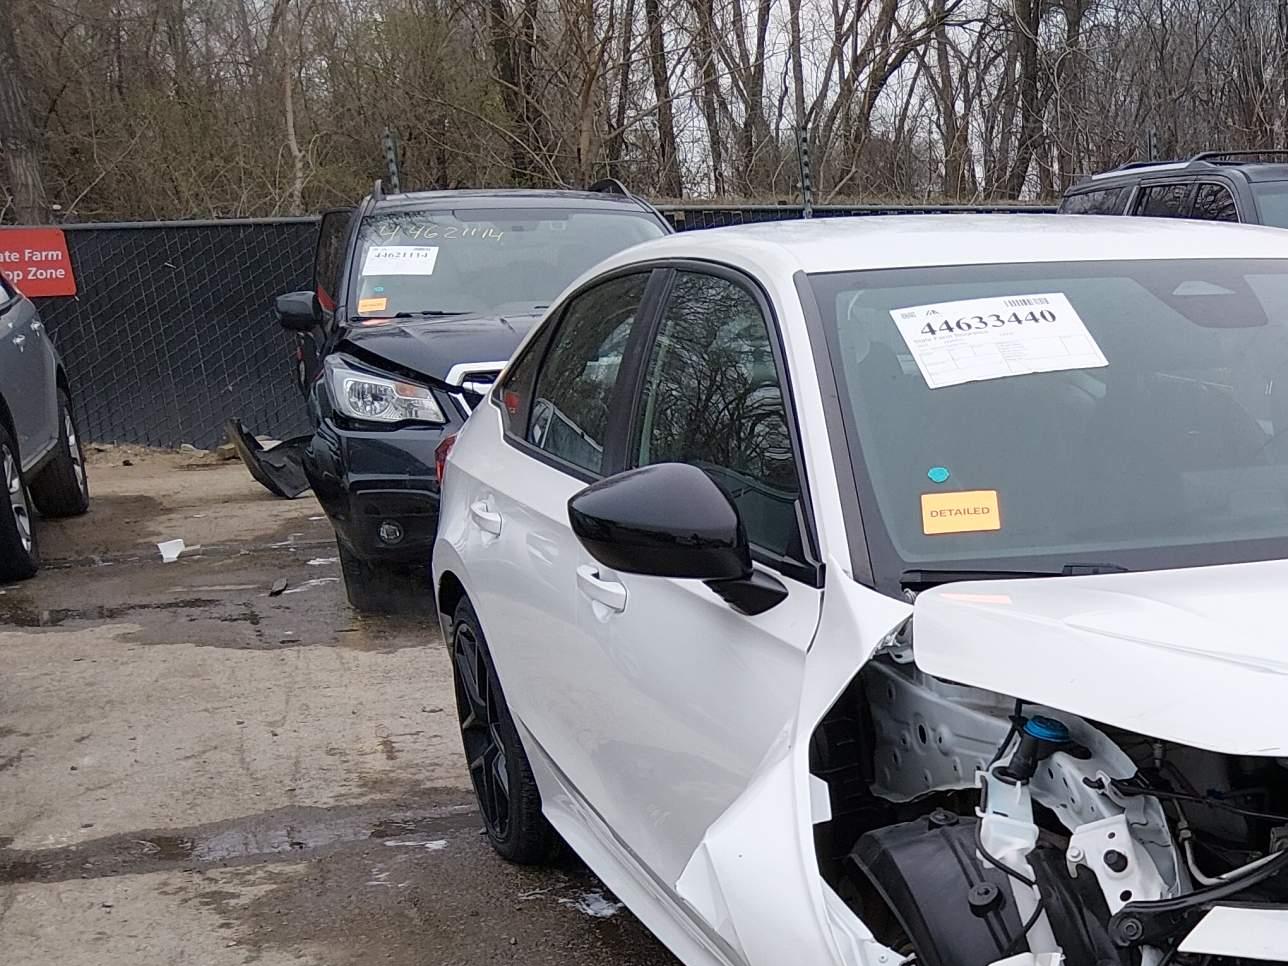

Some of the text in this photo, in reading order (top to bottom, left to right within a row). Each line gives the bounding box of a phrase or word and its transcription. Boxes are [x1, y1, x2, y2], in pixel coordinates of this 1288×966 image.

[24, 249, 62, 261] Farm
[27, 267, 65, 280] Zone
[920, 309, 1057, 336] 44633440
[930, 506, 990, 518] DETAILED
